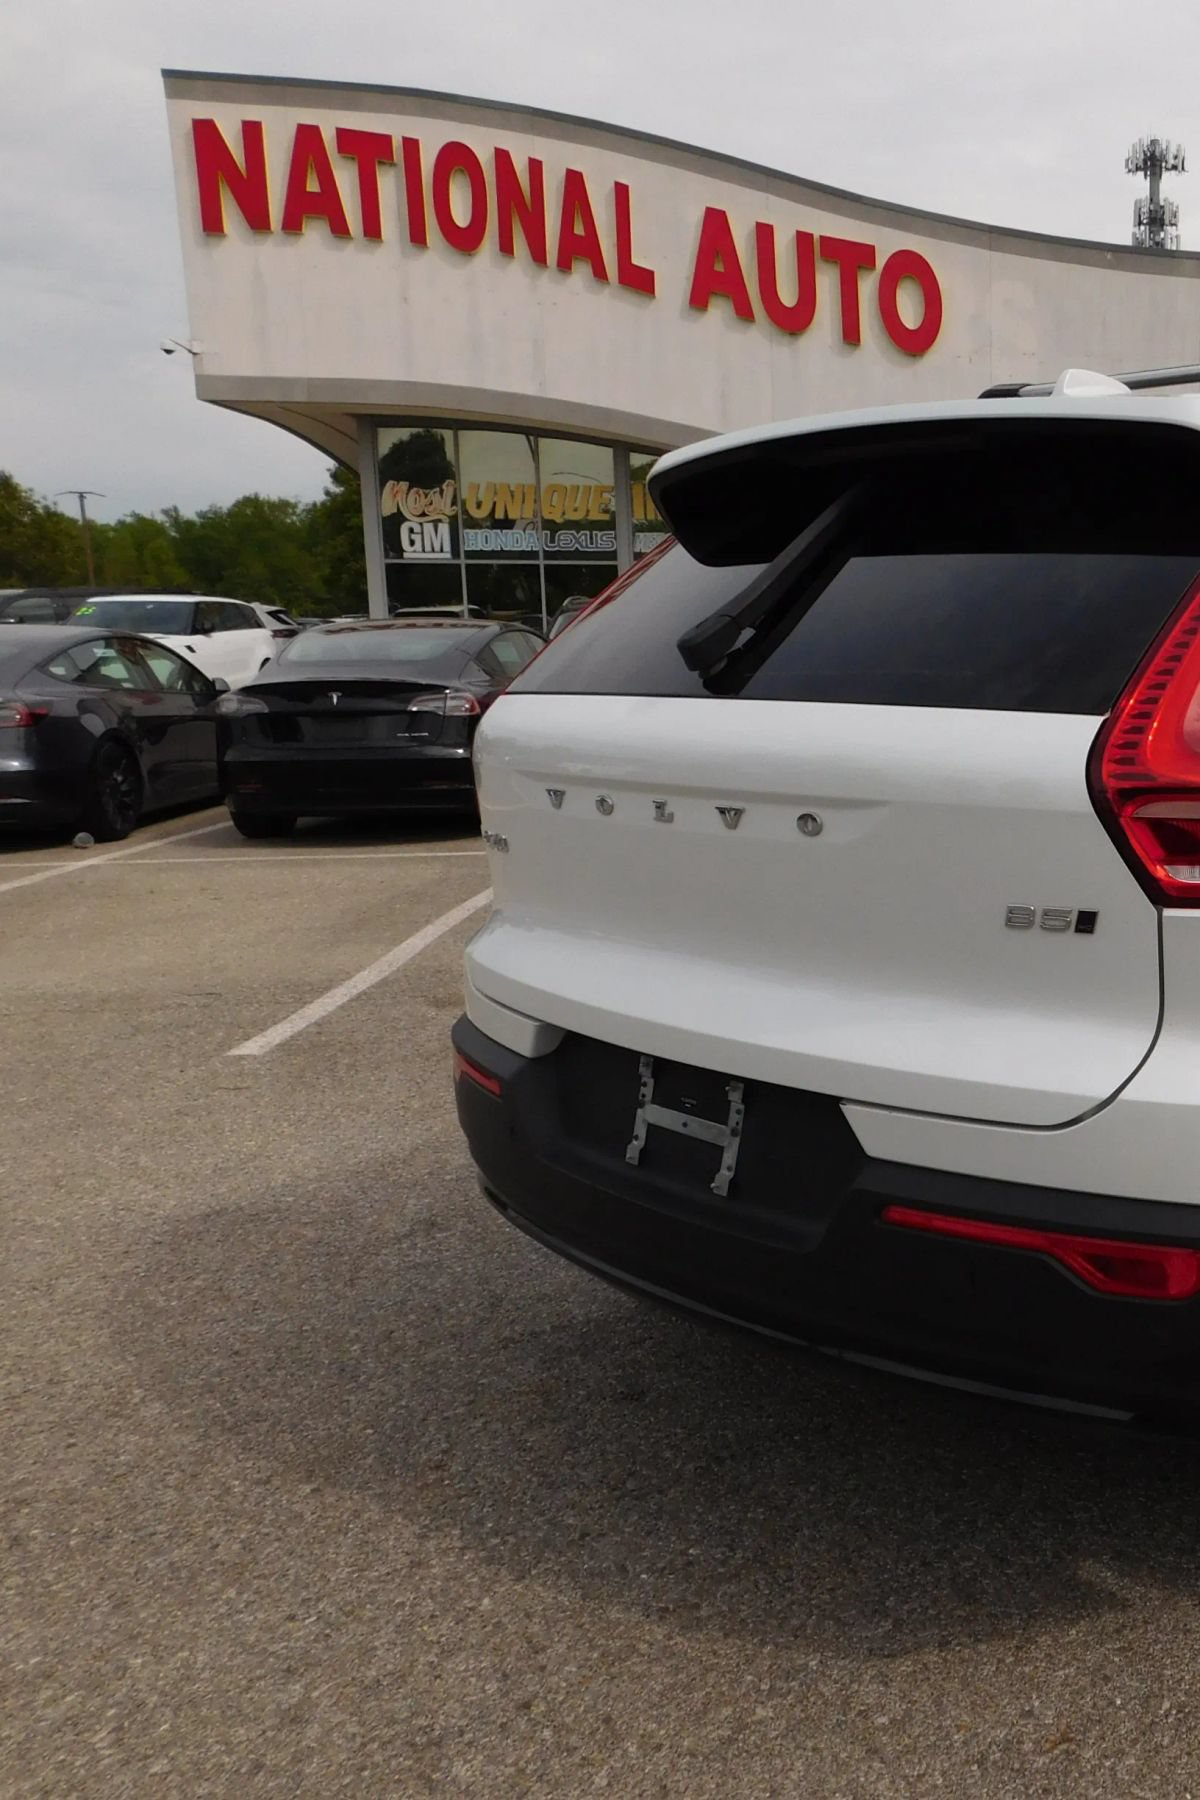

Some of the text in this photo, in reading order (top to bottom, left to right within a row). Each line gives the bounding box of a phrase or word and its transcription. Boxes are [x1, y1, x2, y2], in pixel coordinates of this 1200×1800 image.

[192, 118, 943, 356] NATIONAL AUTO
[382, 480, 457, 522] Most
[465, 481, 612, 522] UNIQUE
[402, 522, 451, 556] GM
[464, 530, 539, 550] HONDA
[543, 531, 615, 550] LEXUS
[545, 788, 823, 837] VOLVO
